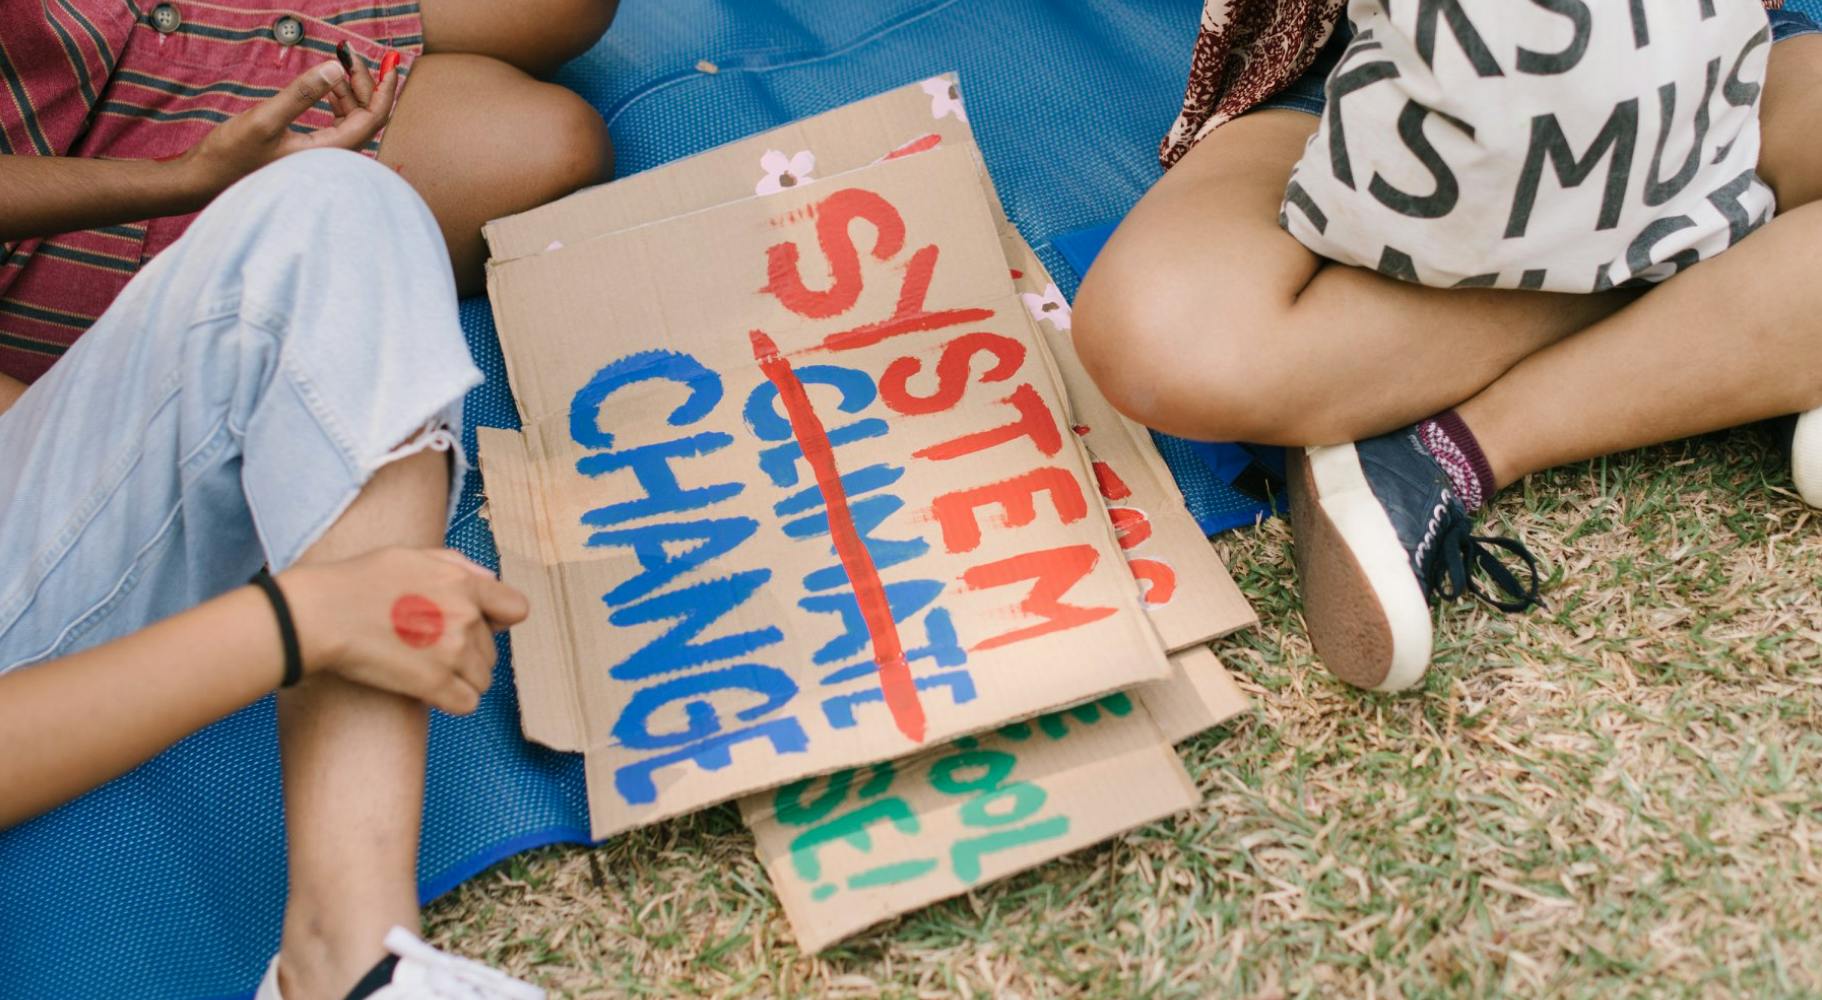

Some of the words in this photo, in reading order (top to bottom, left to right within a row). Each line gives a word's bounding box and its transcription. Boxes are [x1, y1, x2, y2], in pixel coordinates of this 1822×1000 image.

[569, 348, 808, 806] CHANGE
[743, 363, 979, 729] CLIMATE
[762, 188, 1119, 652] SYSTEM
[927, 722, 1070, 884] OOL
